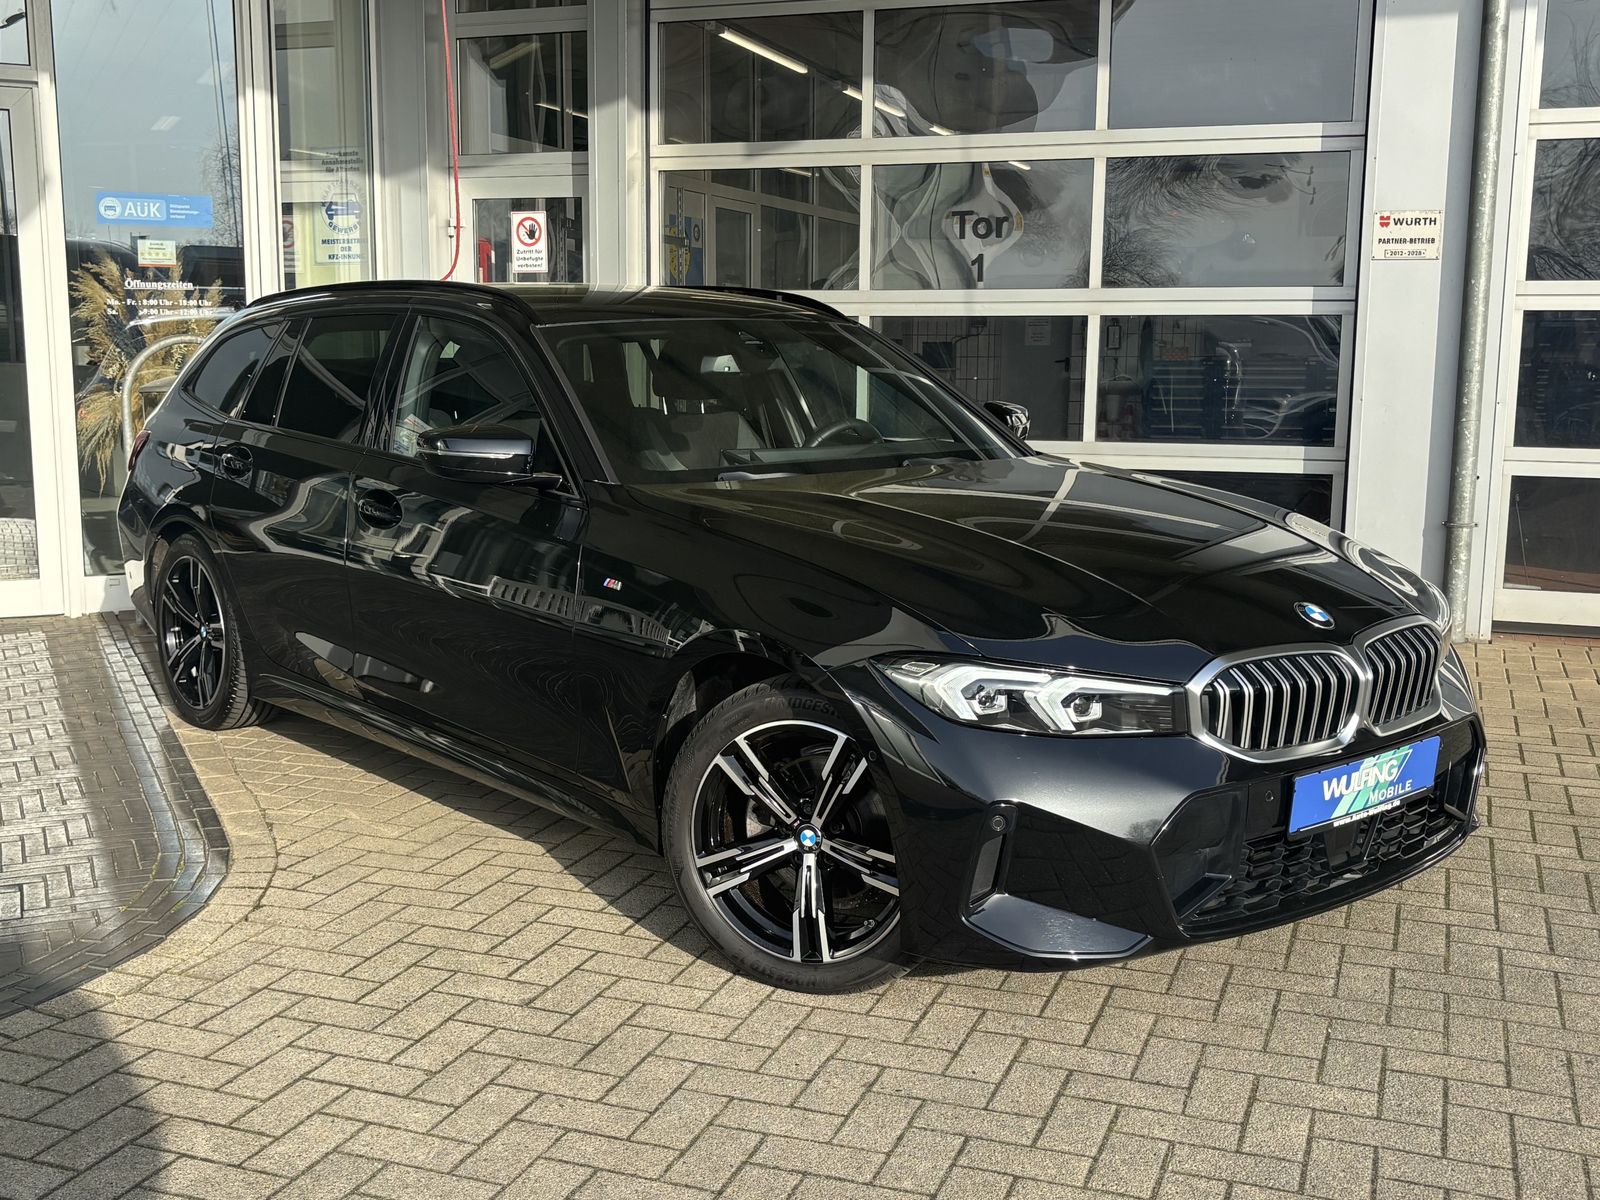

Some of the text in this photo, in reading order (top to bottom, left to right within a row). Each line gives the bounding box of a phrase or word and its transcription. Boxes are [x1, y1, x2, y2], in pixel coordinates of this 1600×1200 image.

[951, 210, 1009, 240] Tor
[1378, 237, 1436, 245] PARTNER-BETRIEB
[970, 253, 985, 282] 1
[124, 278, 194, 290] Öffnungszeiten
[1368, 779, 1413, 805] MOBILE
